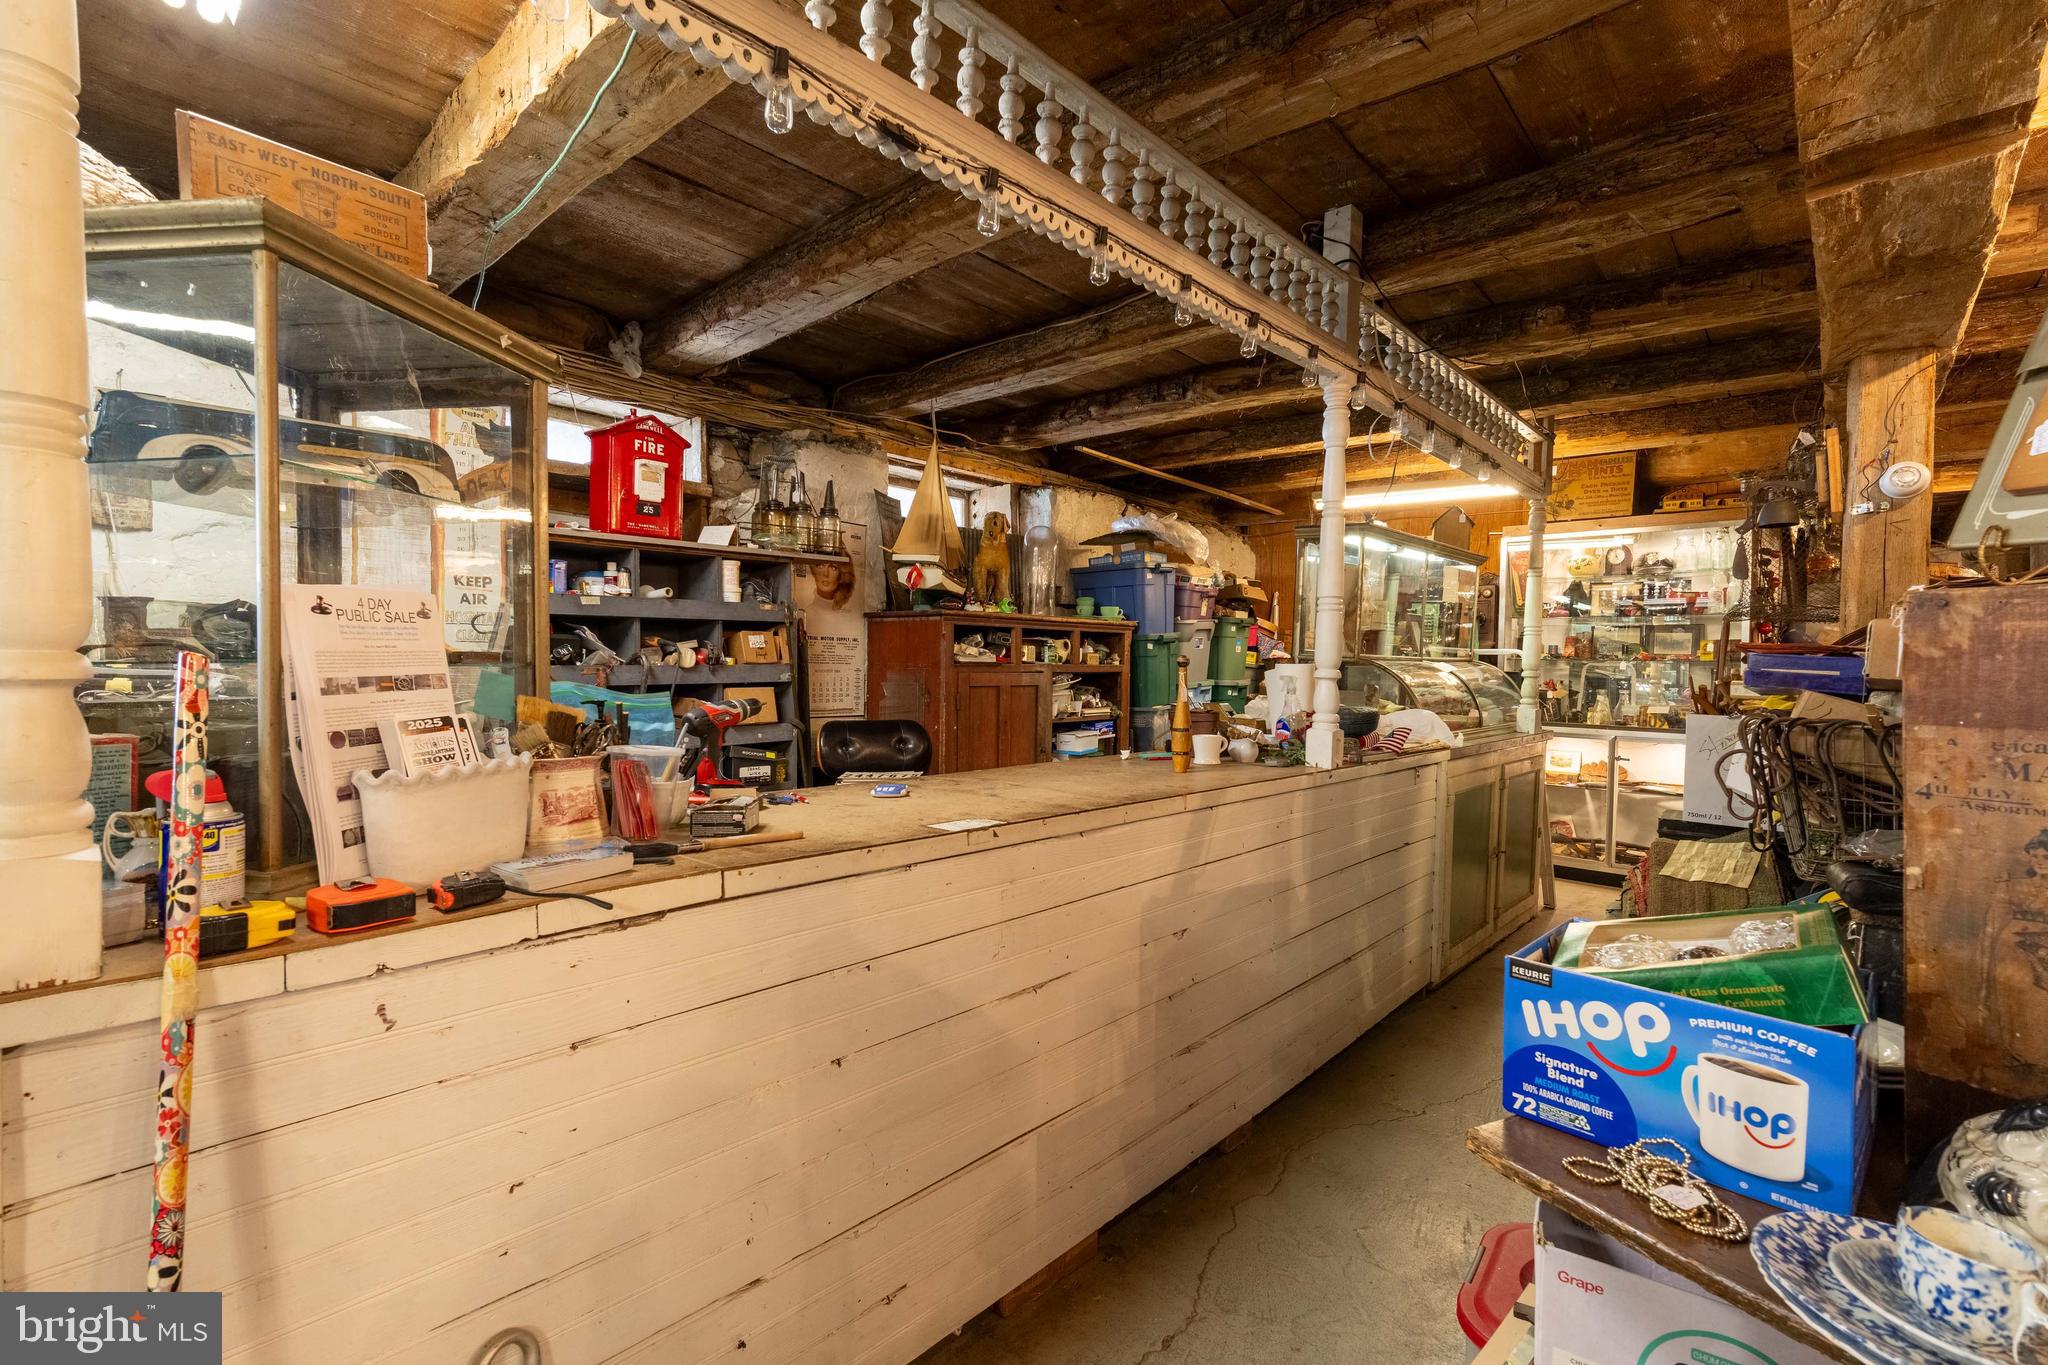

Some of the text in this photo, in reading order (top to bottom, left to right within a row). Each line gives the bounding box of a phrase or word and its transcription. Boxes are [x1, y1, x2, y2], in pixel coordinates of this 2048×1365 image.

[227, 165, 270, 184] COAST
[363, 208, 400, 226] BORDER
[364, 225, 401, 242] BORDER
[634, 439, 665, 456] FIRE
[643, 505, 654, 514] 25
[453, 574, 493, 589] KEEP
[357, 597, 392, 611] 4 DAY
[459, 592, 488, 605] AIR
[335, 608, 417, 624] PUBLIC SALE
[407, 718, 443, 731] 2025
[415, 752, 456, 766] SHOW
[1511, 965, 1550, 982] KEURIG
[1690, 987, 1717, 998] Glass
[1720, 983, 1785, 996] Ornaments
[1521, 999, 1671, 1058] IHOP
[1689, 1018, 1818, 1058] PREMIUM COFFEE
[1534, 1051, 1598, 1080] Signature
[1547, 1067, 1585, 1089] Blend
[1534, 1076, 1600, 1104] MEDIUM ROAST
[1512, 1092, 1537, 1117] 72
[1523, 1082, 1614, 1121] 100% ARABICA GROUND COFFEE
[1707, 1091, 1796, 1140] IHOP
[1557, 1270, 1604, 1295] Grape
